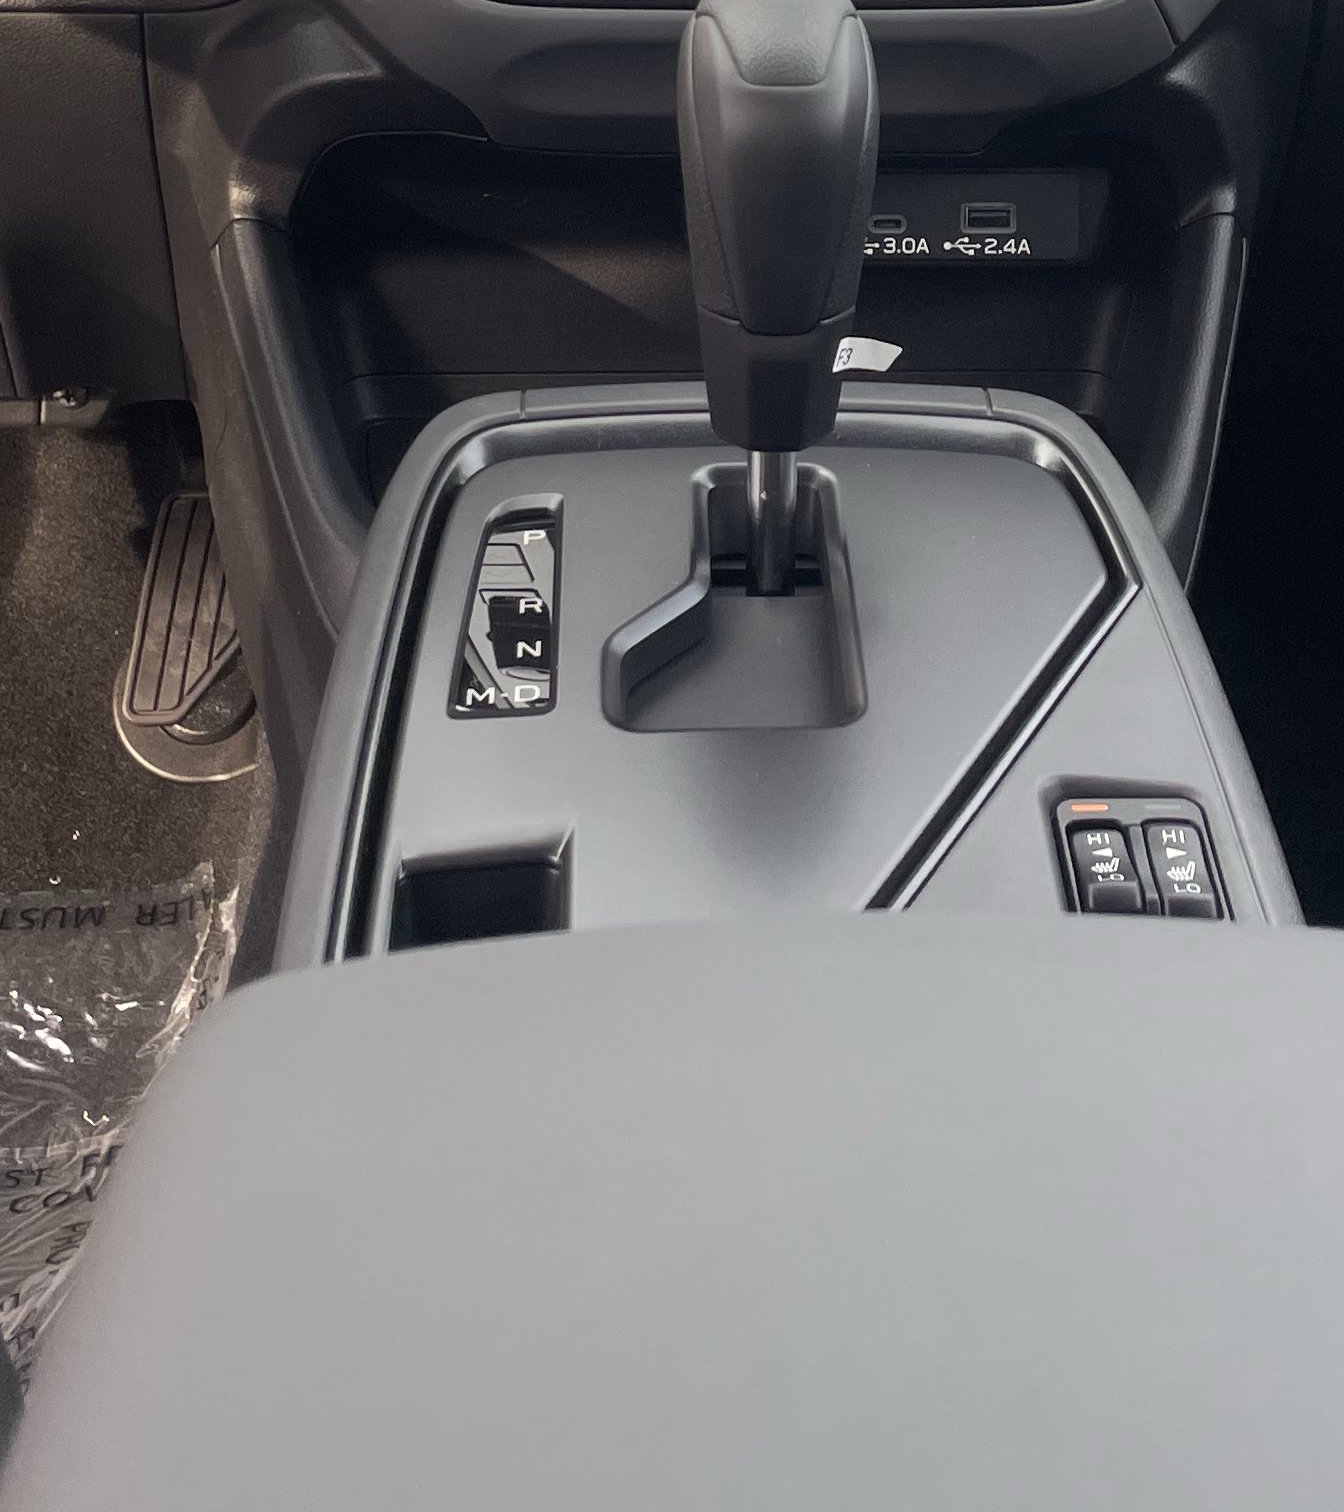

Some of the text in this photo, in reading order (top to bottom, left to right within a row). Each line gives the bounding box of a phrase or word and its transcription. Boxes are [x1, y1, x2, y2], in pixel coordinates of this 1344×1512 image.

[882, 237, 930, 255] 3.0A
[983, 238, 1031, 255] 2.4A
[523, 529, 547, 545] P
[518, 597, 544, 615] R
[516, 640, 542, 659] N
[1086, 832, 1110, 845] HI
[1161, 828, 1185, 845] HI
[1097, 872, 1125, 882] LO
[1173, 882, 1202, 894] LO
